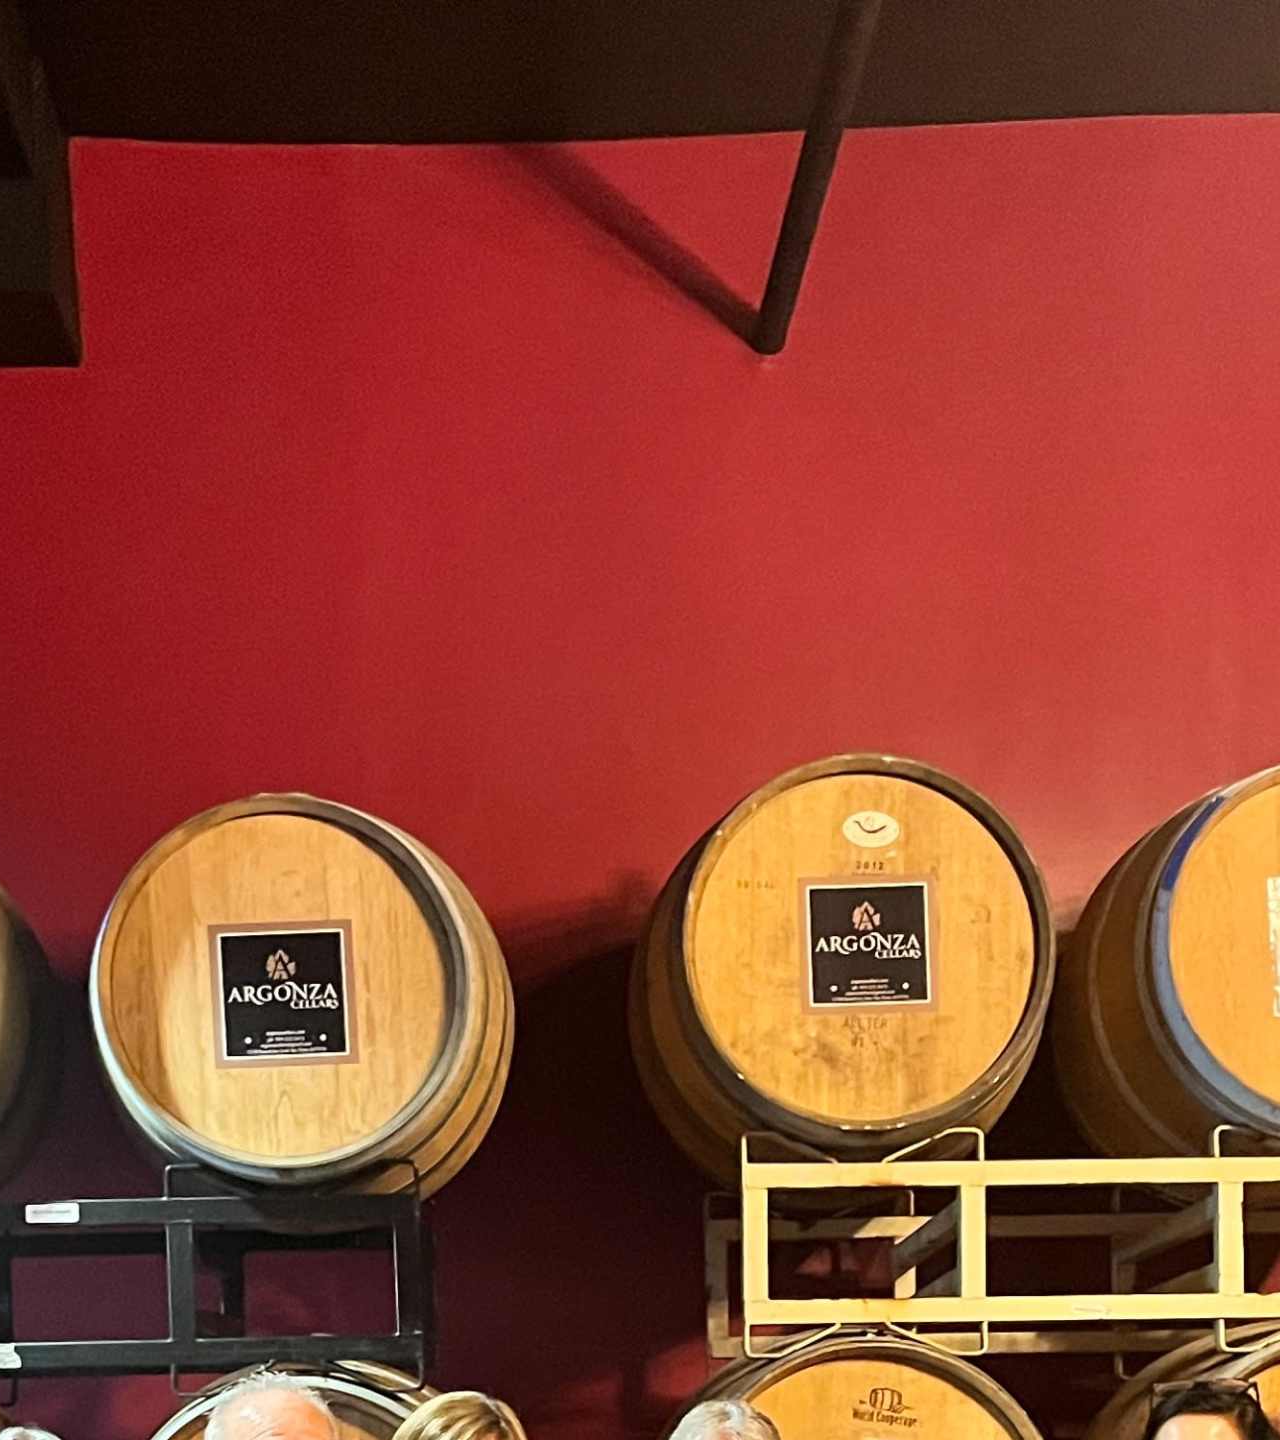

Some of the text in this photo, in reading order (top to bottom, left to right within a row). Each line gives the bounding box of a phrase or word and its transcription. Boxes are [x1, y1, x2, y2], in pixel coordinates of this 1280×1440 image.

[815, 932, 920, 954] ARGONZA
[875, 949, 922, 959] CELLARS
[228, 982, 337, 1005] ARGONZA
[290, 999, 339, 1009] CELLARS
